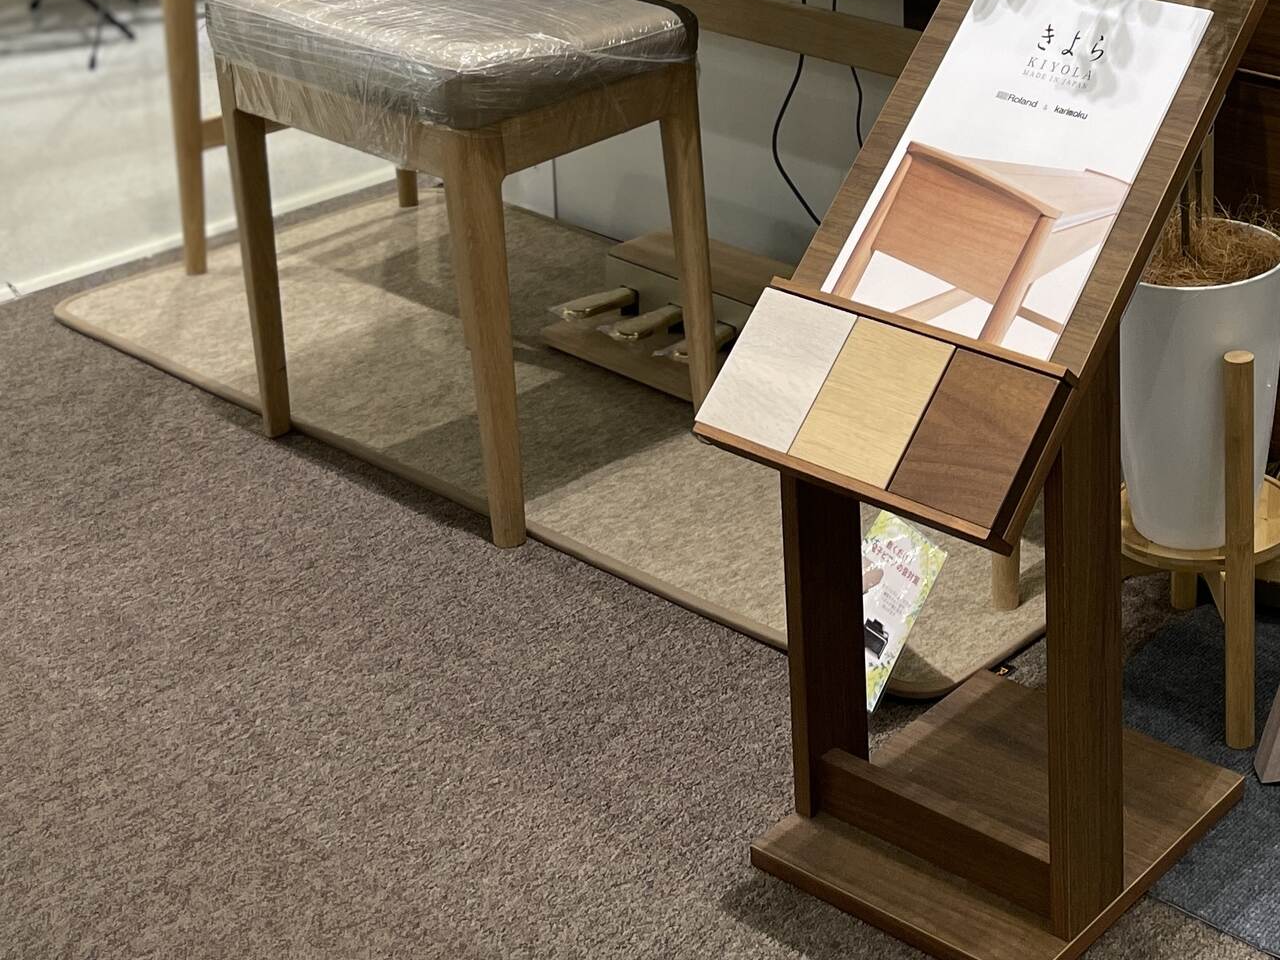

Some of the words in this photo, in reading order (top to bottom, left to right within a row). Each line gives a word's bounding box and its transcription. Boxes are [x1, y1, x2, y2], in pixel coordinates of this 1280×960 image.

[1037, 23, 1104, 62] きよら
[1022, 69, 1046, 80] MADE
[1048, 76, 1059, 84] IN
[1060, 78, 1089, 89] JAPAN
[1027, 56, 1092, 81] KIYOLA
[1007, 93, 1038, 108] Roland
